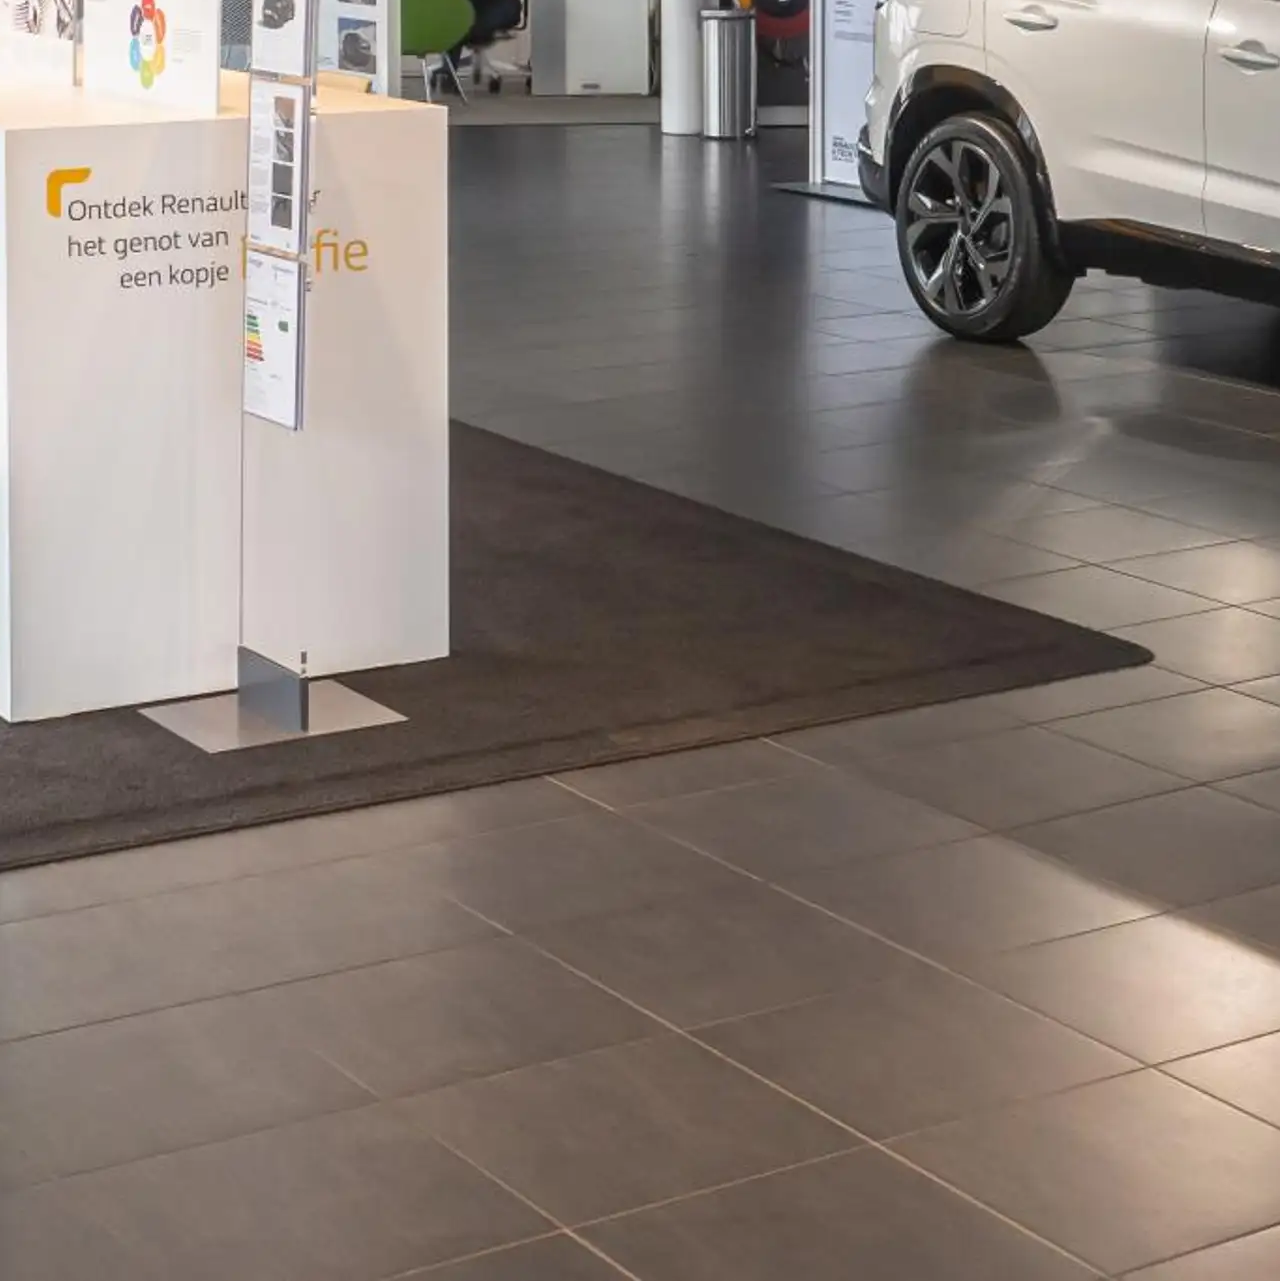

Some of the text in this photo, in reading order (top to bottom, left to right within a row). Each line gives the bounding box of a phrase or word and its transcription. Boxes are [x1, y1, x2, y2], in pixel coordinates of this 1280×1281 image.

[68, 189, 249, 221] Ontdek Renault
[68, 229, 229, 260] het genot van
[120, 268, 162, 288] een
[169, 261, 229, 290] kopje
